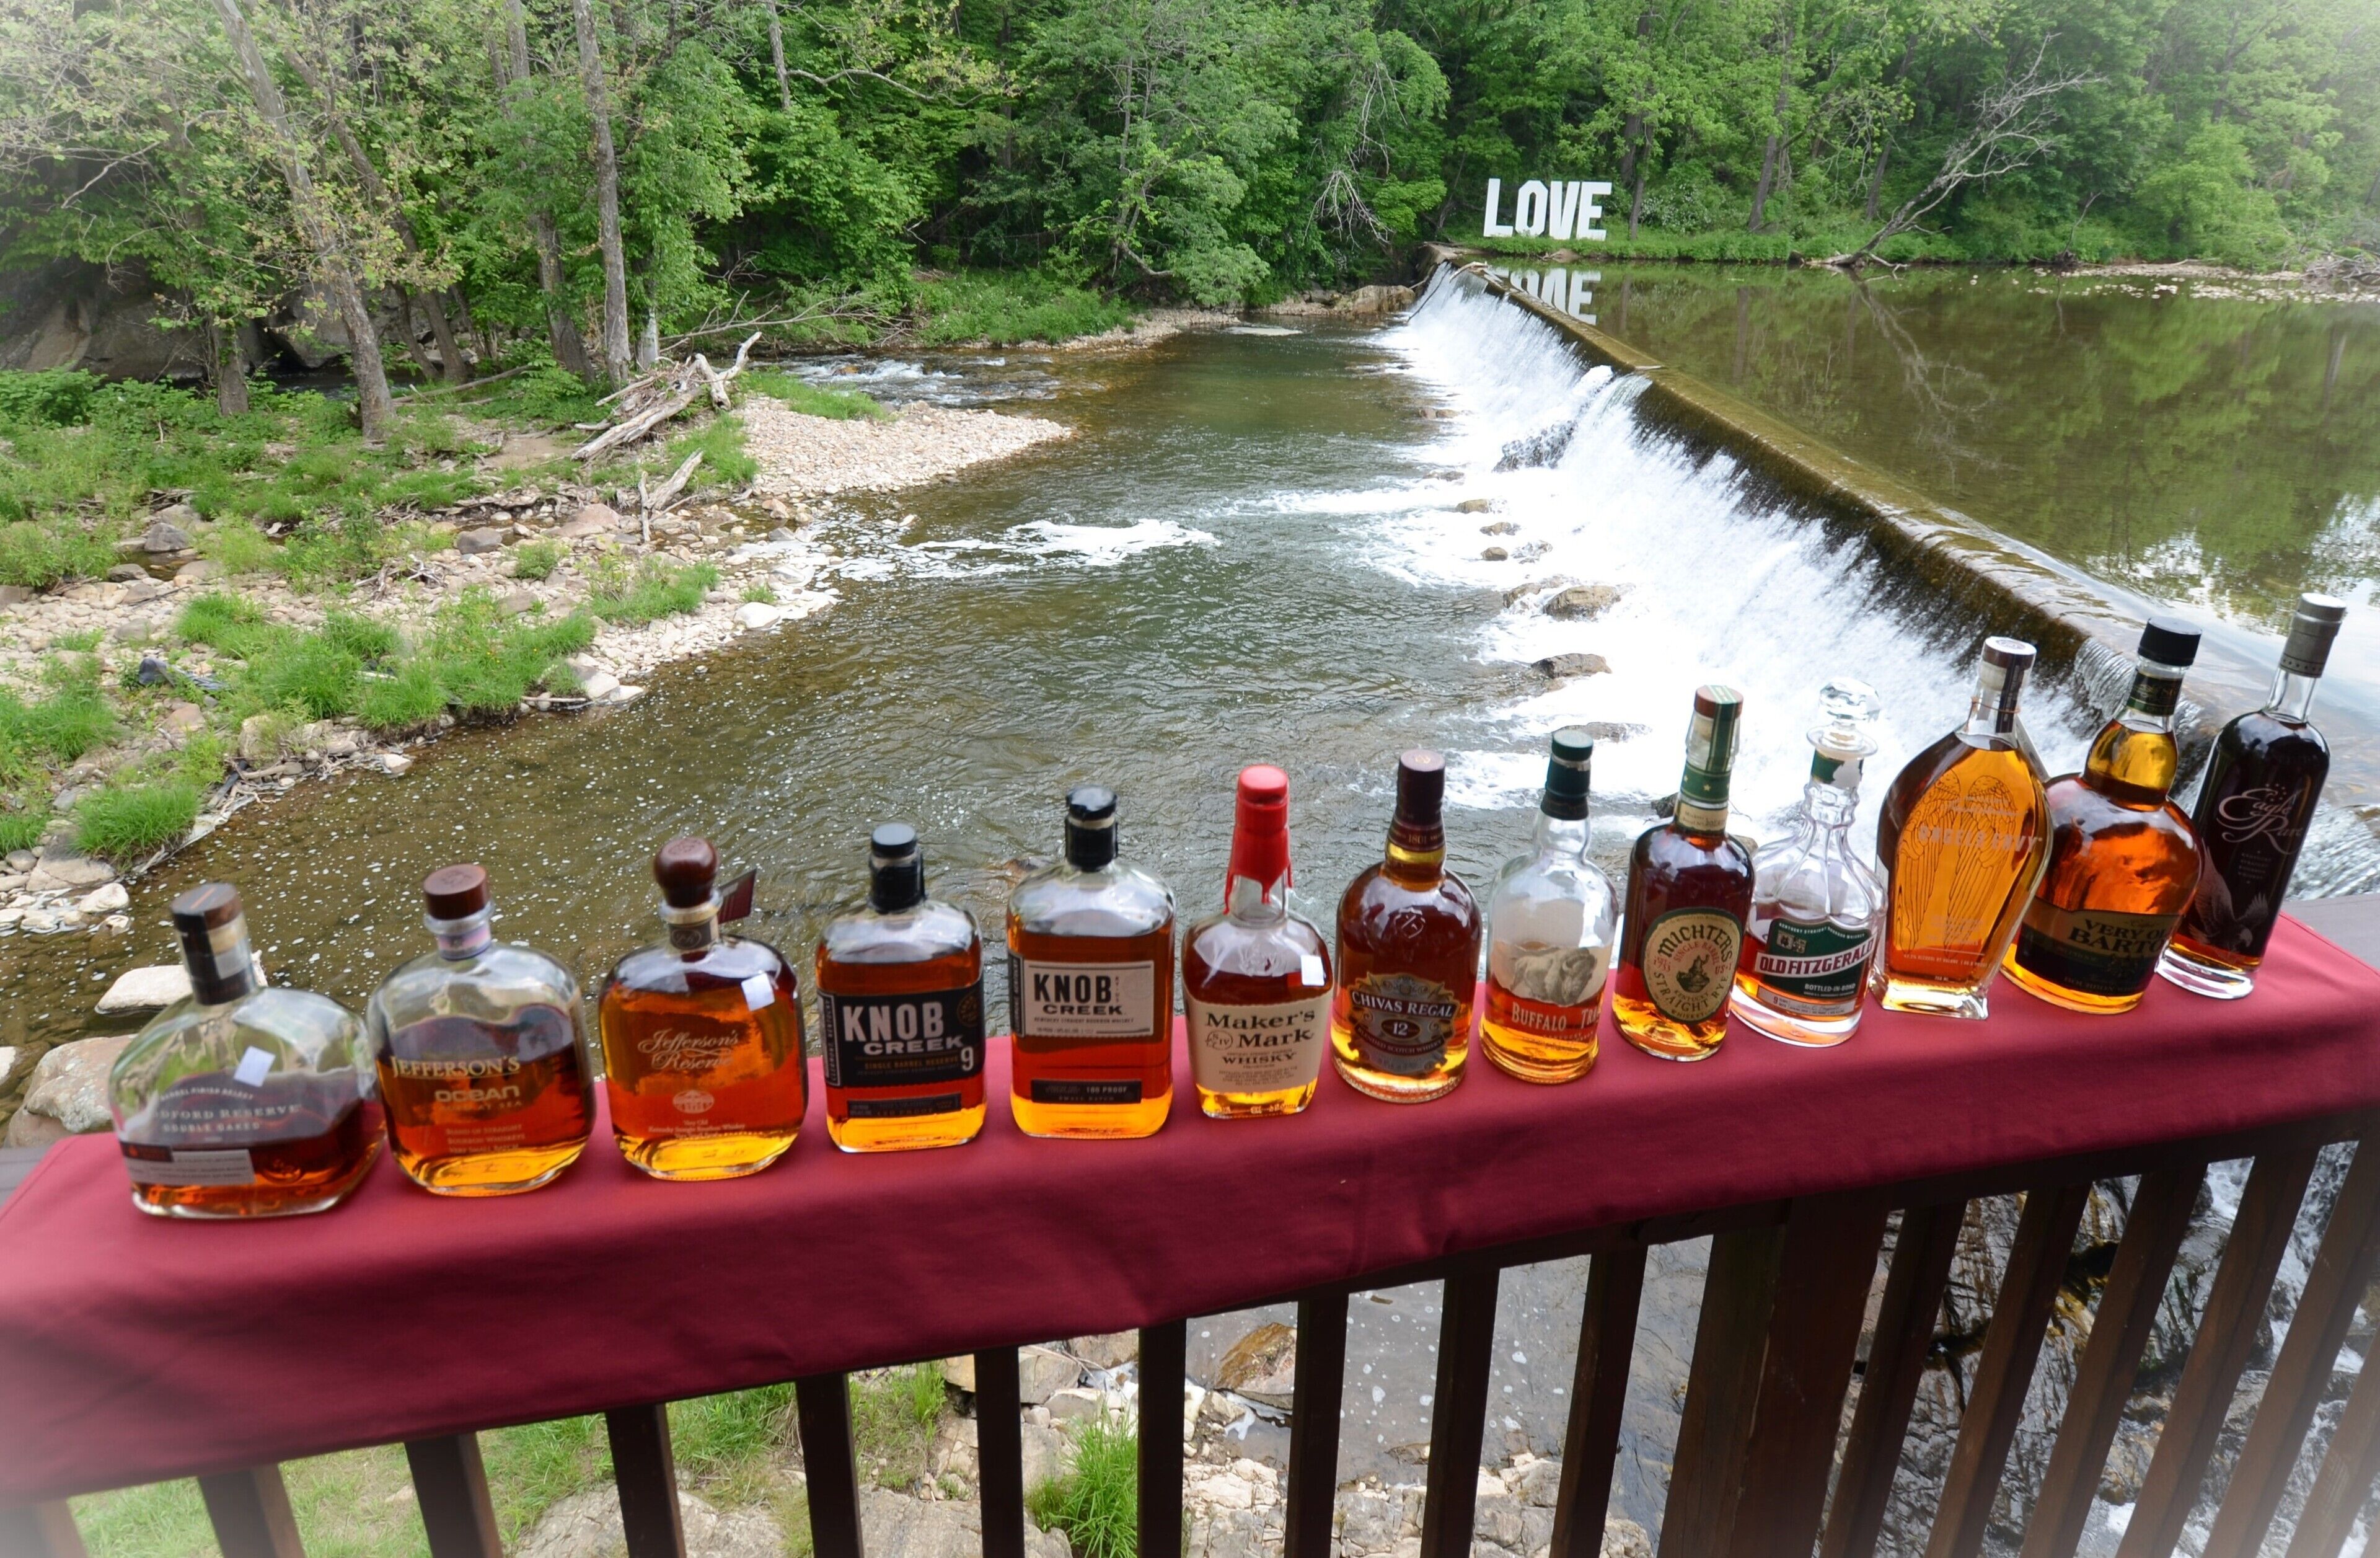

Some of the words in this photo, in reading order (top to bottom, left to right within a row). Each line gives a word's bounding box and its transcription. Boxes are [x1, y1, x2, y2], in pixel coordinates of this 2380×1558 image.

[1483, 178, 1612, 241] LOVE
[2217, 788, 2302, 830] Eagle
[2084, 919, 2140, 939] VERY
[1657, 924, 1733, 963] MICHTER'S
[1759, 956, 1787, 975] OLD
[1787, 938, 1875, 975] FITZGERALD
[1033, 973, 1112, 1004] KNOB
[1654, 972, 1709, 1012] STRAIGHT
[1711, 976, 1728, 999] RYE
[1042, 1004, 1123, 1016] CREEK
[1352, 991, 1403, 1013] CHIVAS
[1408, 1002, 1453, 1018] REGAL
[842, 1001, 944, 1042] KNOB
[1205, 1010, 1315, 1030] Maker's
[1511, 1001, 1567, 1032] BUFFALO
[637, 1027, 739, 1053] Jefferson's
[1238, 1029, 1315, 1049] Mark
[1393, 1022, 1409, 1037] 12
[863, 1035, 964, 1055] CREEK
[1387, 1045, 1416, 1054] SCOTCH
[391, 1055, 521, 1078] JEFFERSON'S
[652, 1050, 733, 1071] Reserve
[865, 1060, 891, 1070] SINGLE
[894, 1058, 923, 1068] BARREL
[961, 1046, 974, 1071] 9
[1222, 1051, 1296, 1065] WHISKY
[220, 1103, 302, 1118] RESERVE
